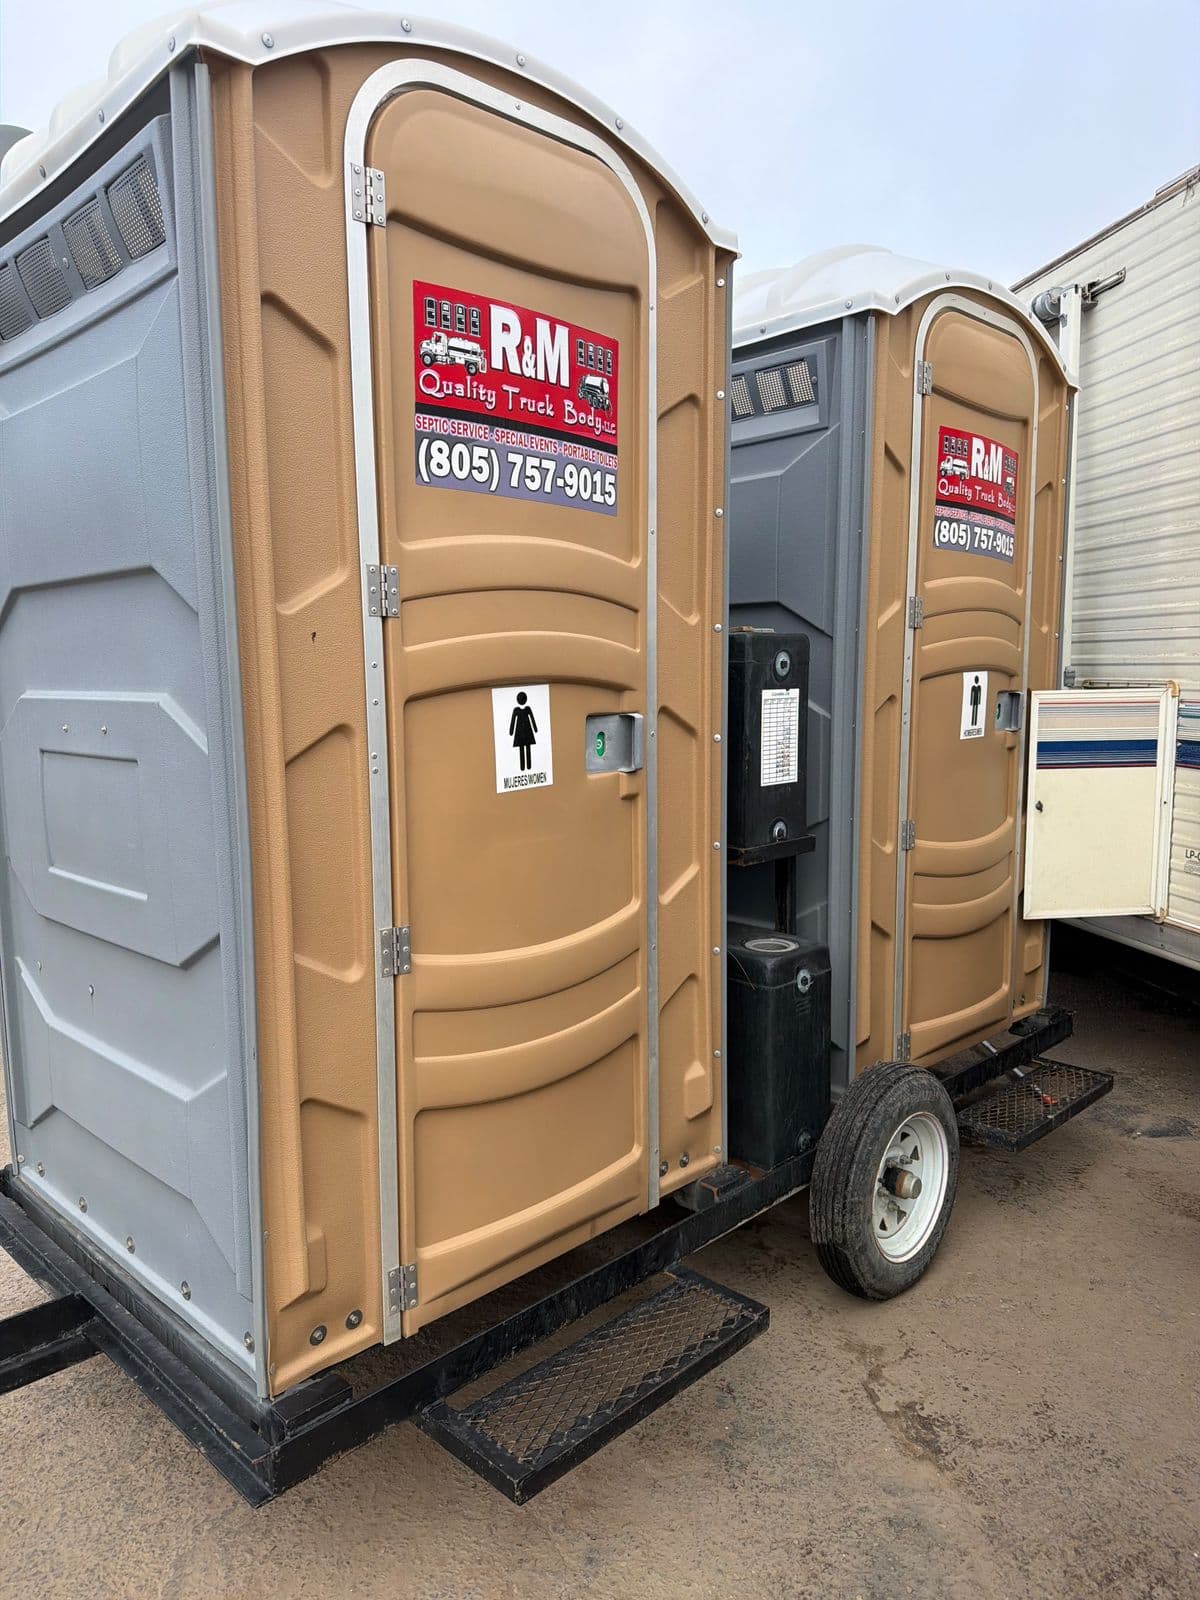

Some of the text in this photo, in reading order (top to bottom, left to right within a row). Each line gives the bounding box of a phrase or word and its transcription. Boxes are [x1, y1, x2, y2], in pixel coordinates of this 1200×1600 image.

[489, 304, 570, 388] R&M
[419, 368, 496, 410] Quality
[502, 384, 554, 417] Truck
[415, 414, 617, 469] SEPTIC SERVICE SPECIAL EVENTS PORTABLE TOILETS
[971, 436, 1003, 485] R&M
[418, 438, 617, 507] (805) 757-9015
[938, 478, 972, 501] Quality
[974, 485, 995, 503] Truck
[934, 520, 971, 550] (805)
[974, 526, 1014, 557] 757-9015
